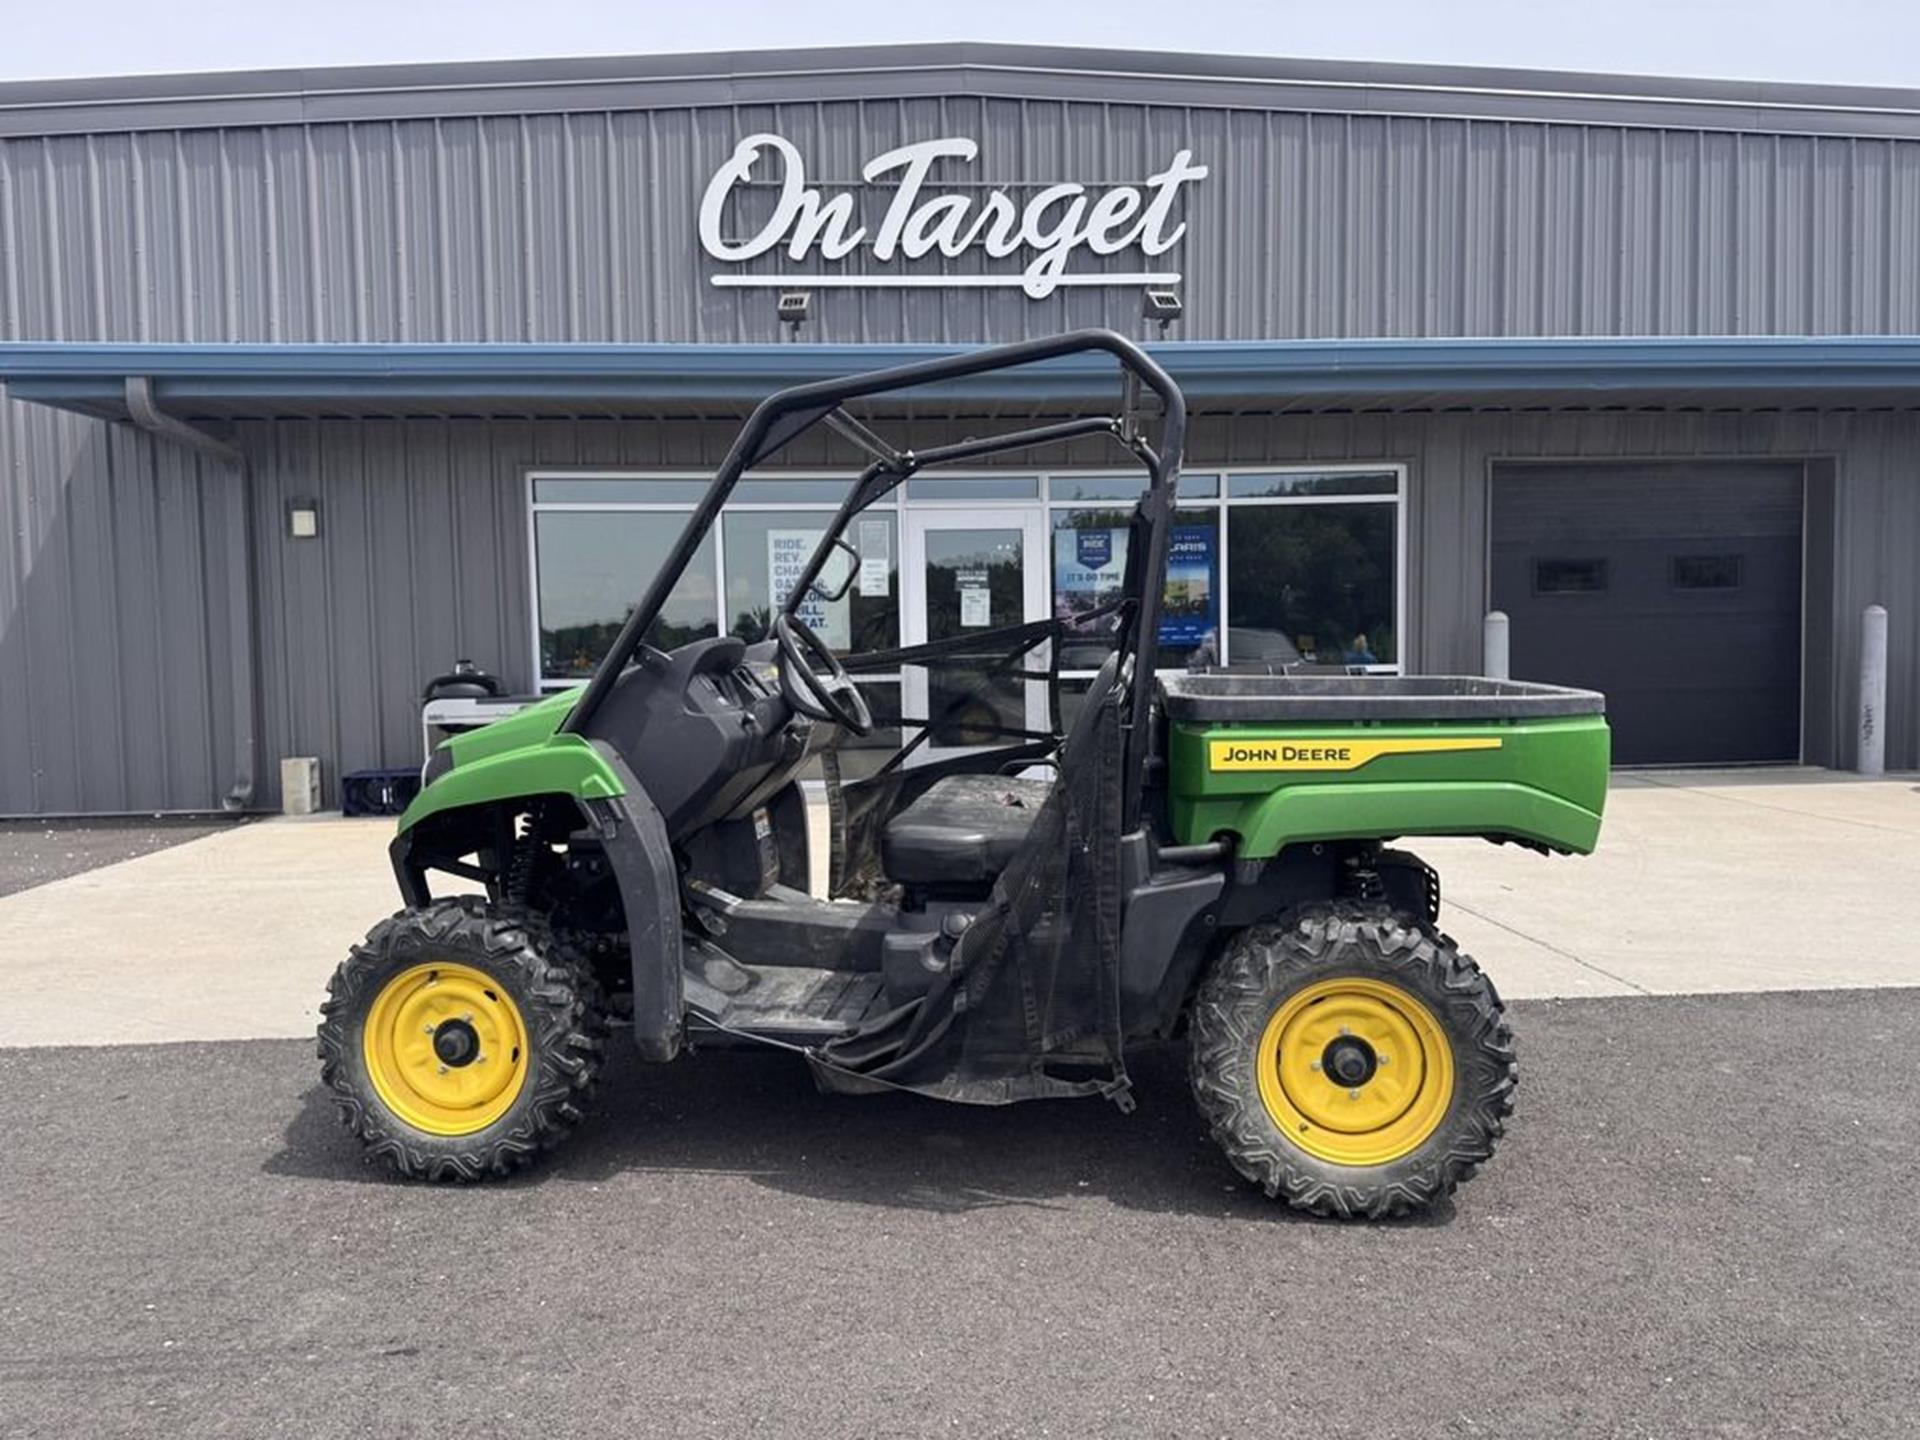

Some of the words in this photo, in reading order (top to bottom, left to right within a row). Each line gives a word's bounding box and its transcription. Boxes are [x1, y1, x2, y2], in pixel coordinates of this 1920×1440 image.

[698, 133, 866, 261] On
[863, 137, 1209, 299] Target
[1223, 747, 1277, 762] JOHN
[1282, 746, 1351, 761] DEERE
